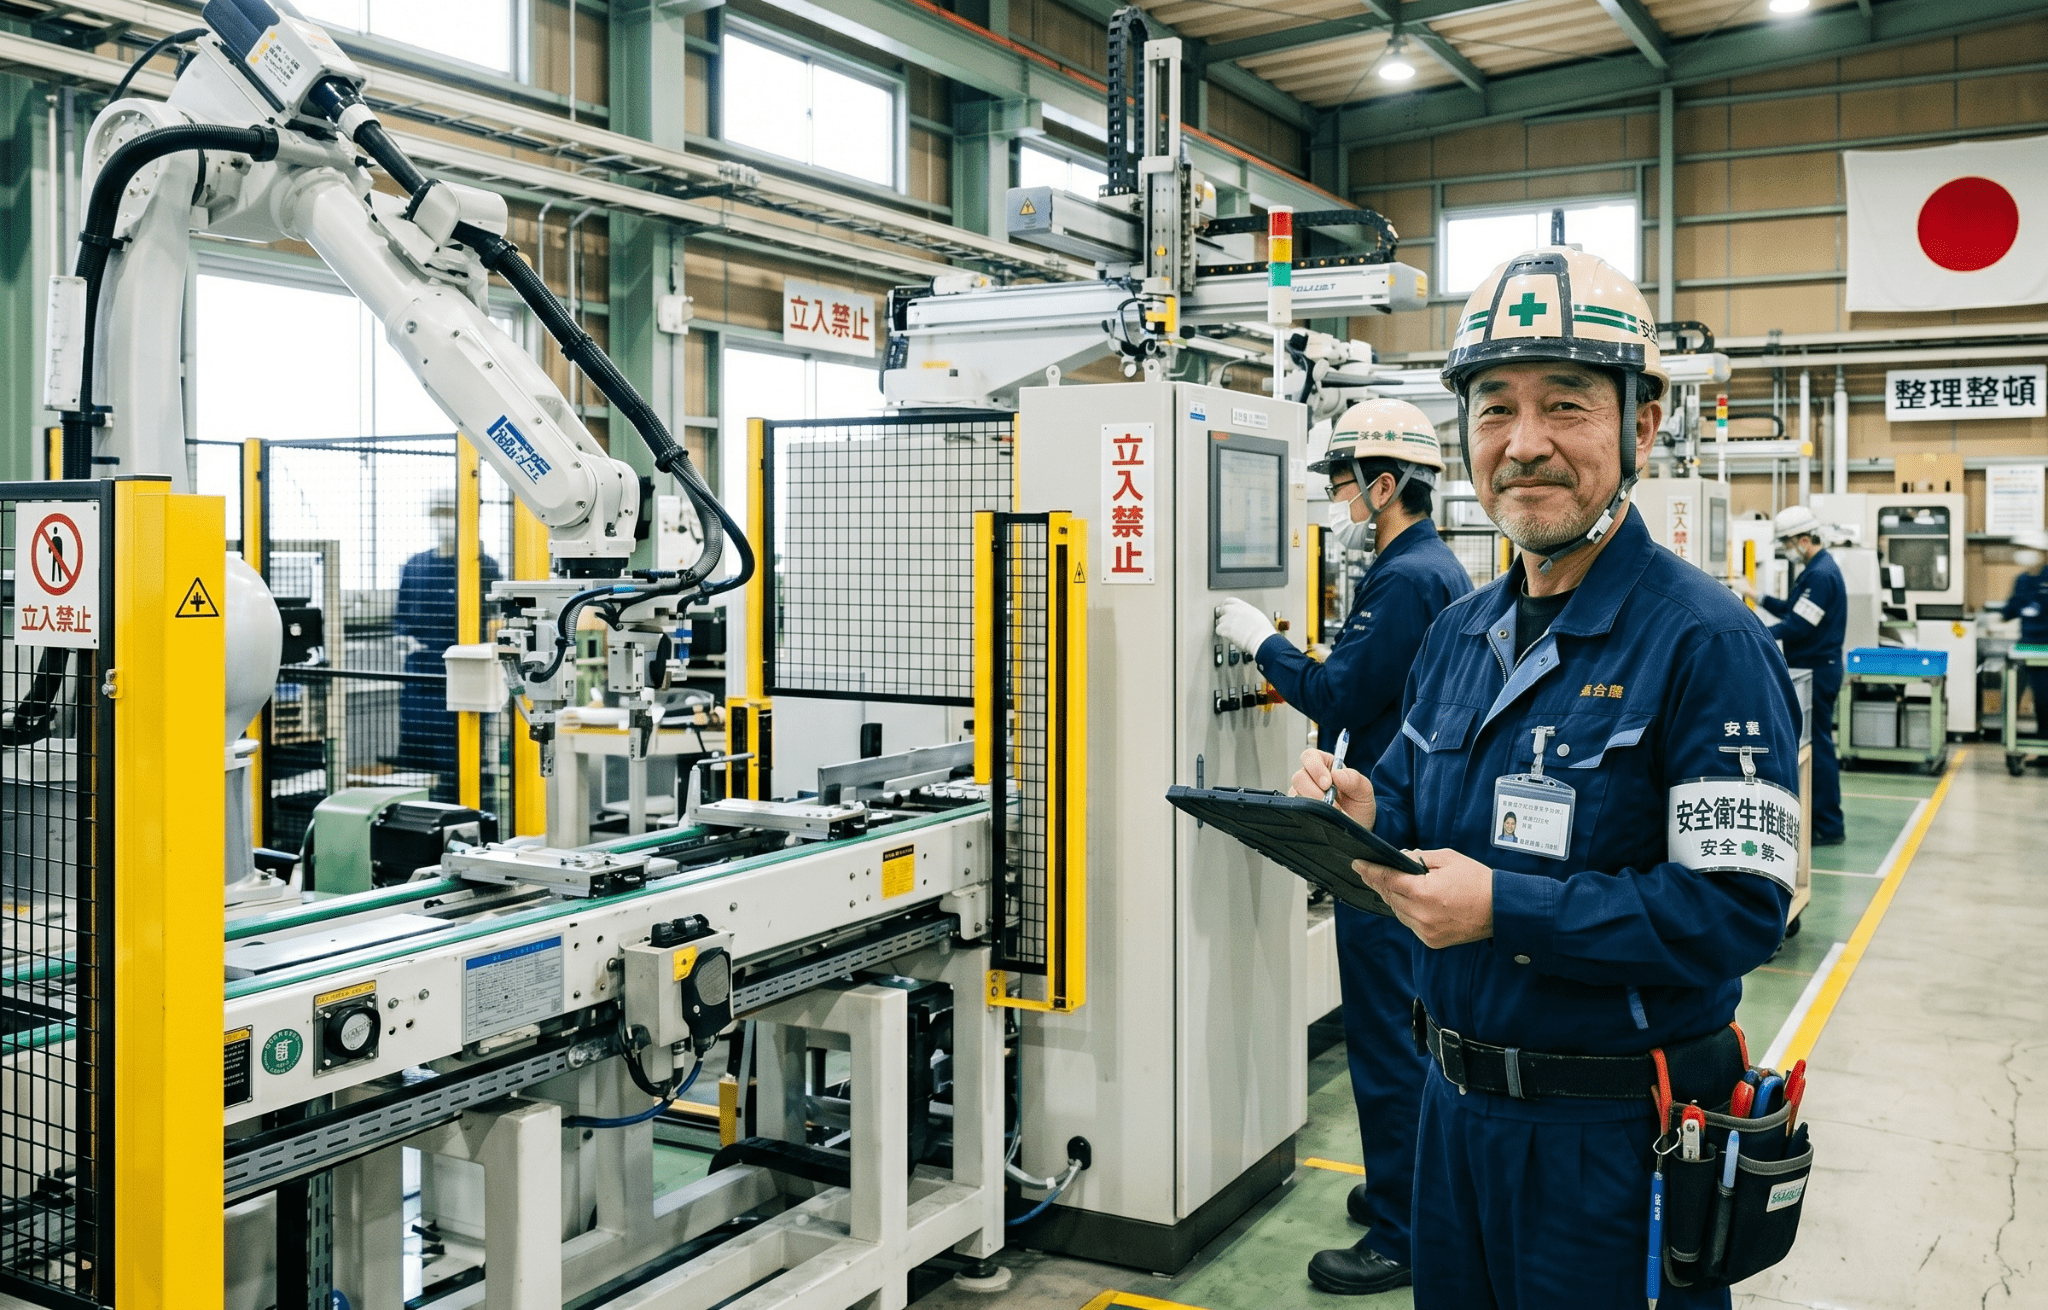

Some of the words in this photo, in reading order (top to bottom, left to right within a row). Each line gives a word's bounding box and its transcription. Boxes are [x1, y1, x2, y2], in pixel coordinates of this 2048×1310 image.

[790, 295, 869, 341] 立入禁止
[1895, 375, 2036, 409] 整理整頓
[1111, 433, 1145, 573] 立入禁止
[21, 604, 92, 633] 立入禁止
[1700, 838, 1738, 857] 安全
